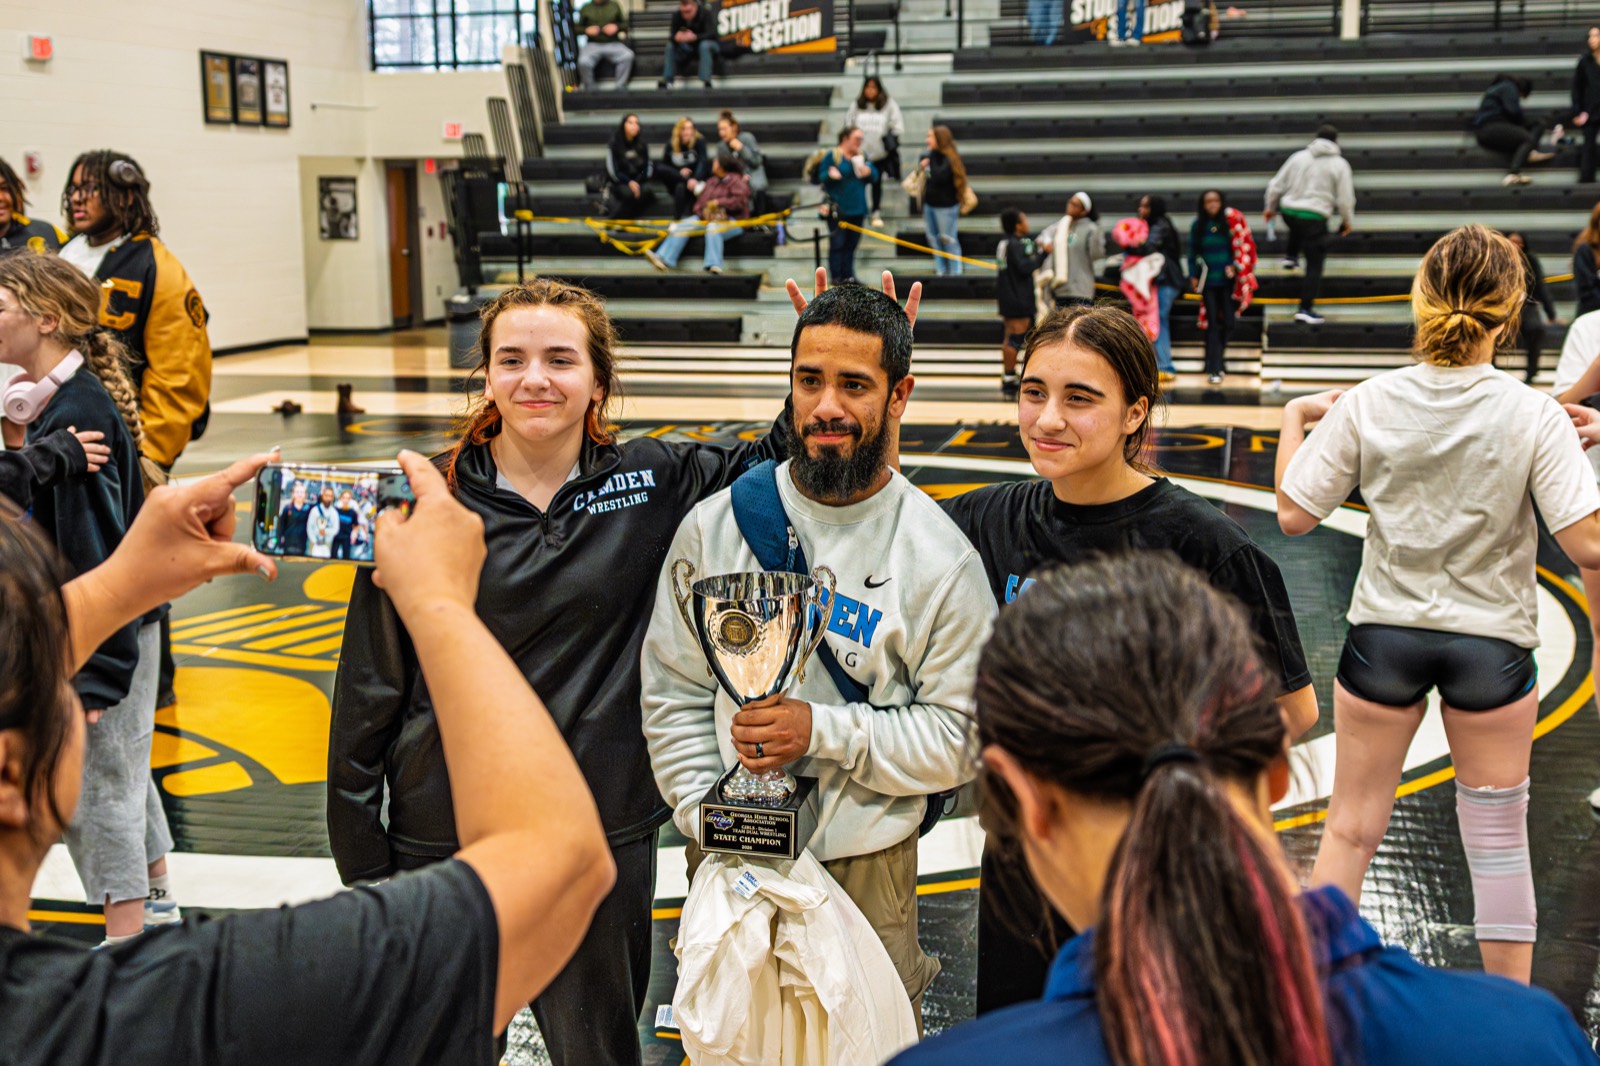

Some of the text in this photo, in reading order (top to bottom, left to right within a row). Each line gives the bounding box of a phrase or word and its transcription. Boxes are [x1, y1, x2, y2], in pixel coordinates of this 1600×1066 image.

[717, 0, 790, 36] STUDENT
[750, 11, 822, 53] SECTION
[98, 277, 143, 331] C
[573, 469, 657, 512] CAMDEN
[586, 491, 649, 516] WRESTLING
[730, 811, 753, 819] GEORGIA
[768, 815, 789, 823] SCHOOL
[742, 818, 776, 826] ASSOCIATION
[713, 833, 781, 846] STATE CHAMPION
[759, 830, 787, 838] WRESTLING
